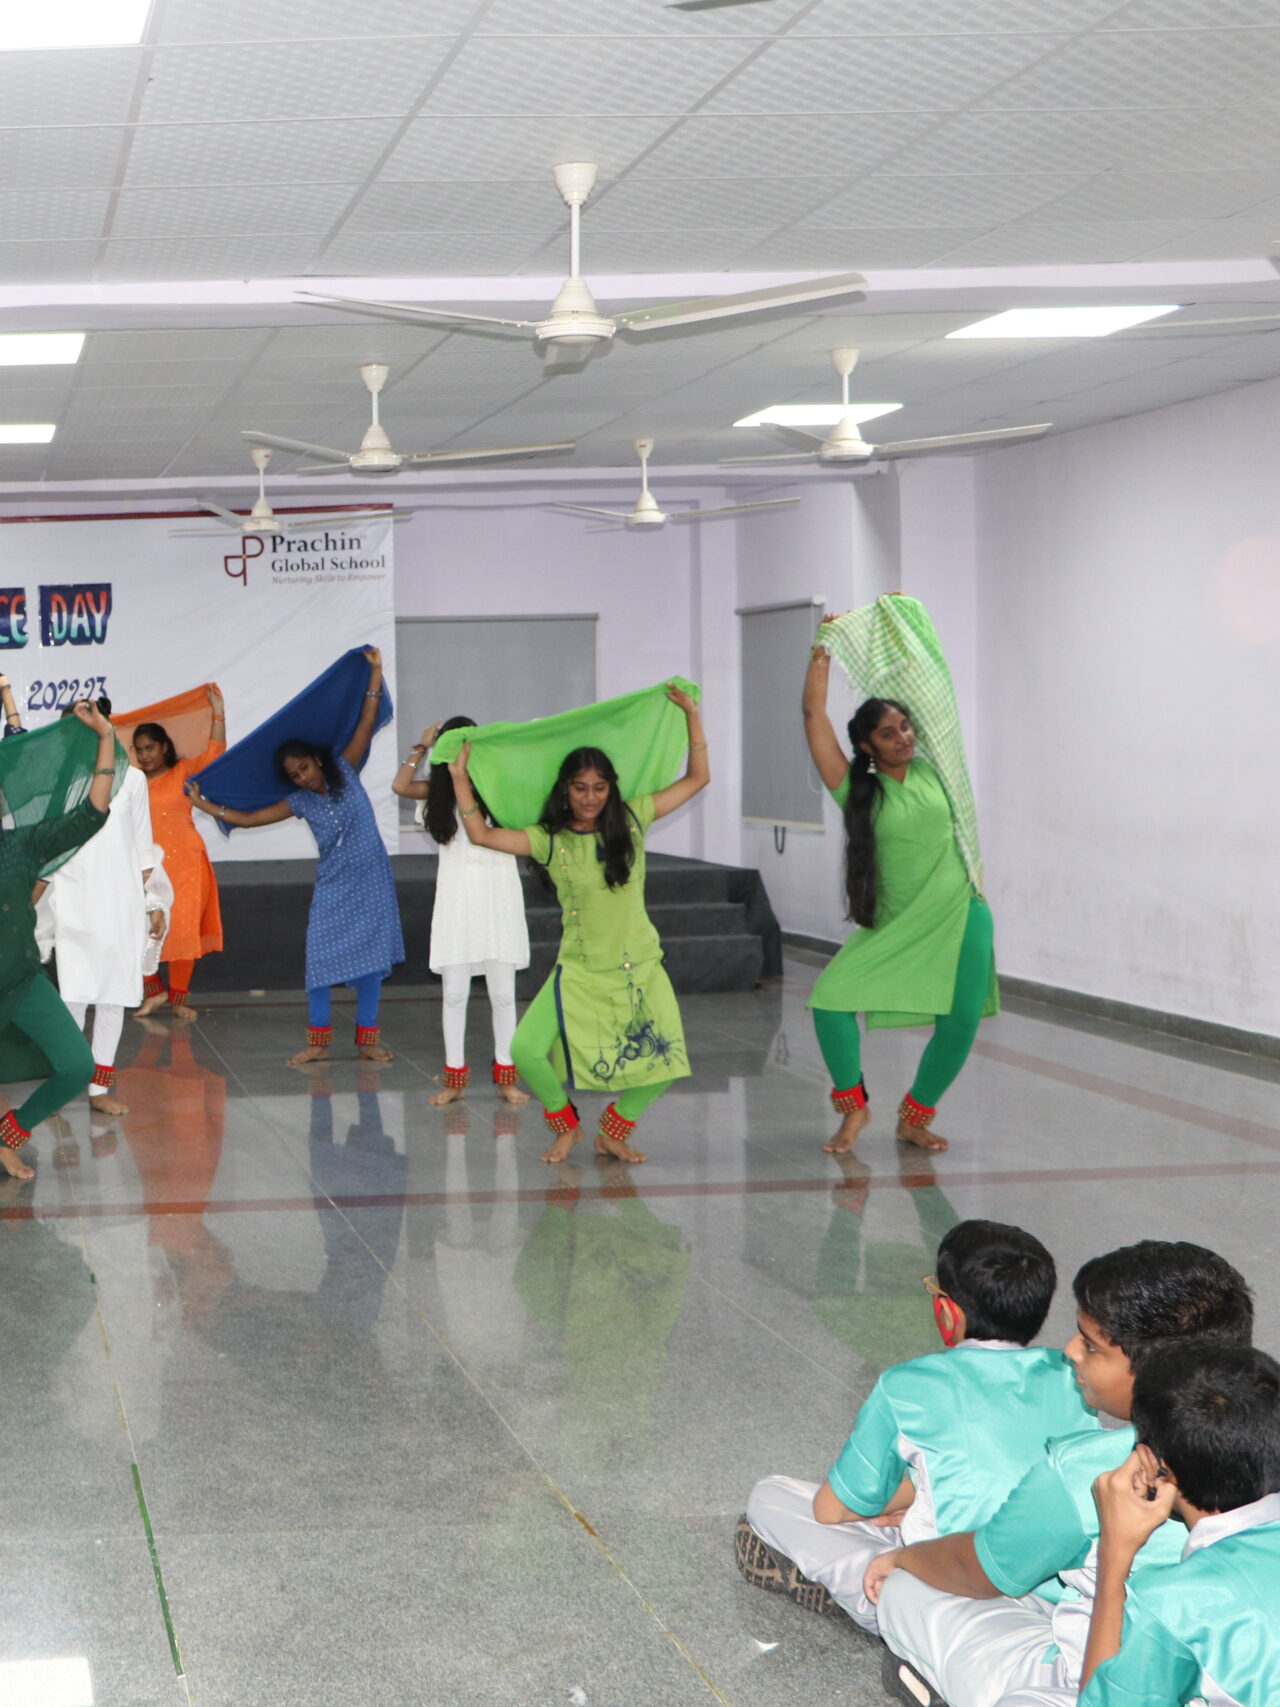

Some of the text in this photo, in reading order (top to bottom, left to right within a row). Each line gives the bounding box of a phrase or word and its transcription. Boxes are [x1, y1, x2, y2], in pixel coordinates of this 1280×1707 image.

[271, 532, 362, 553] Prachin
[271, 555, 386, 573] Global School
[50, 591, 108, 640] DAY
